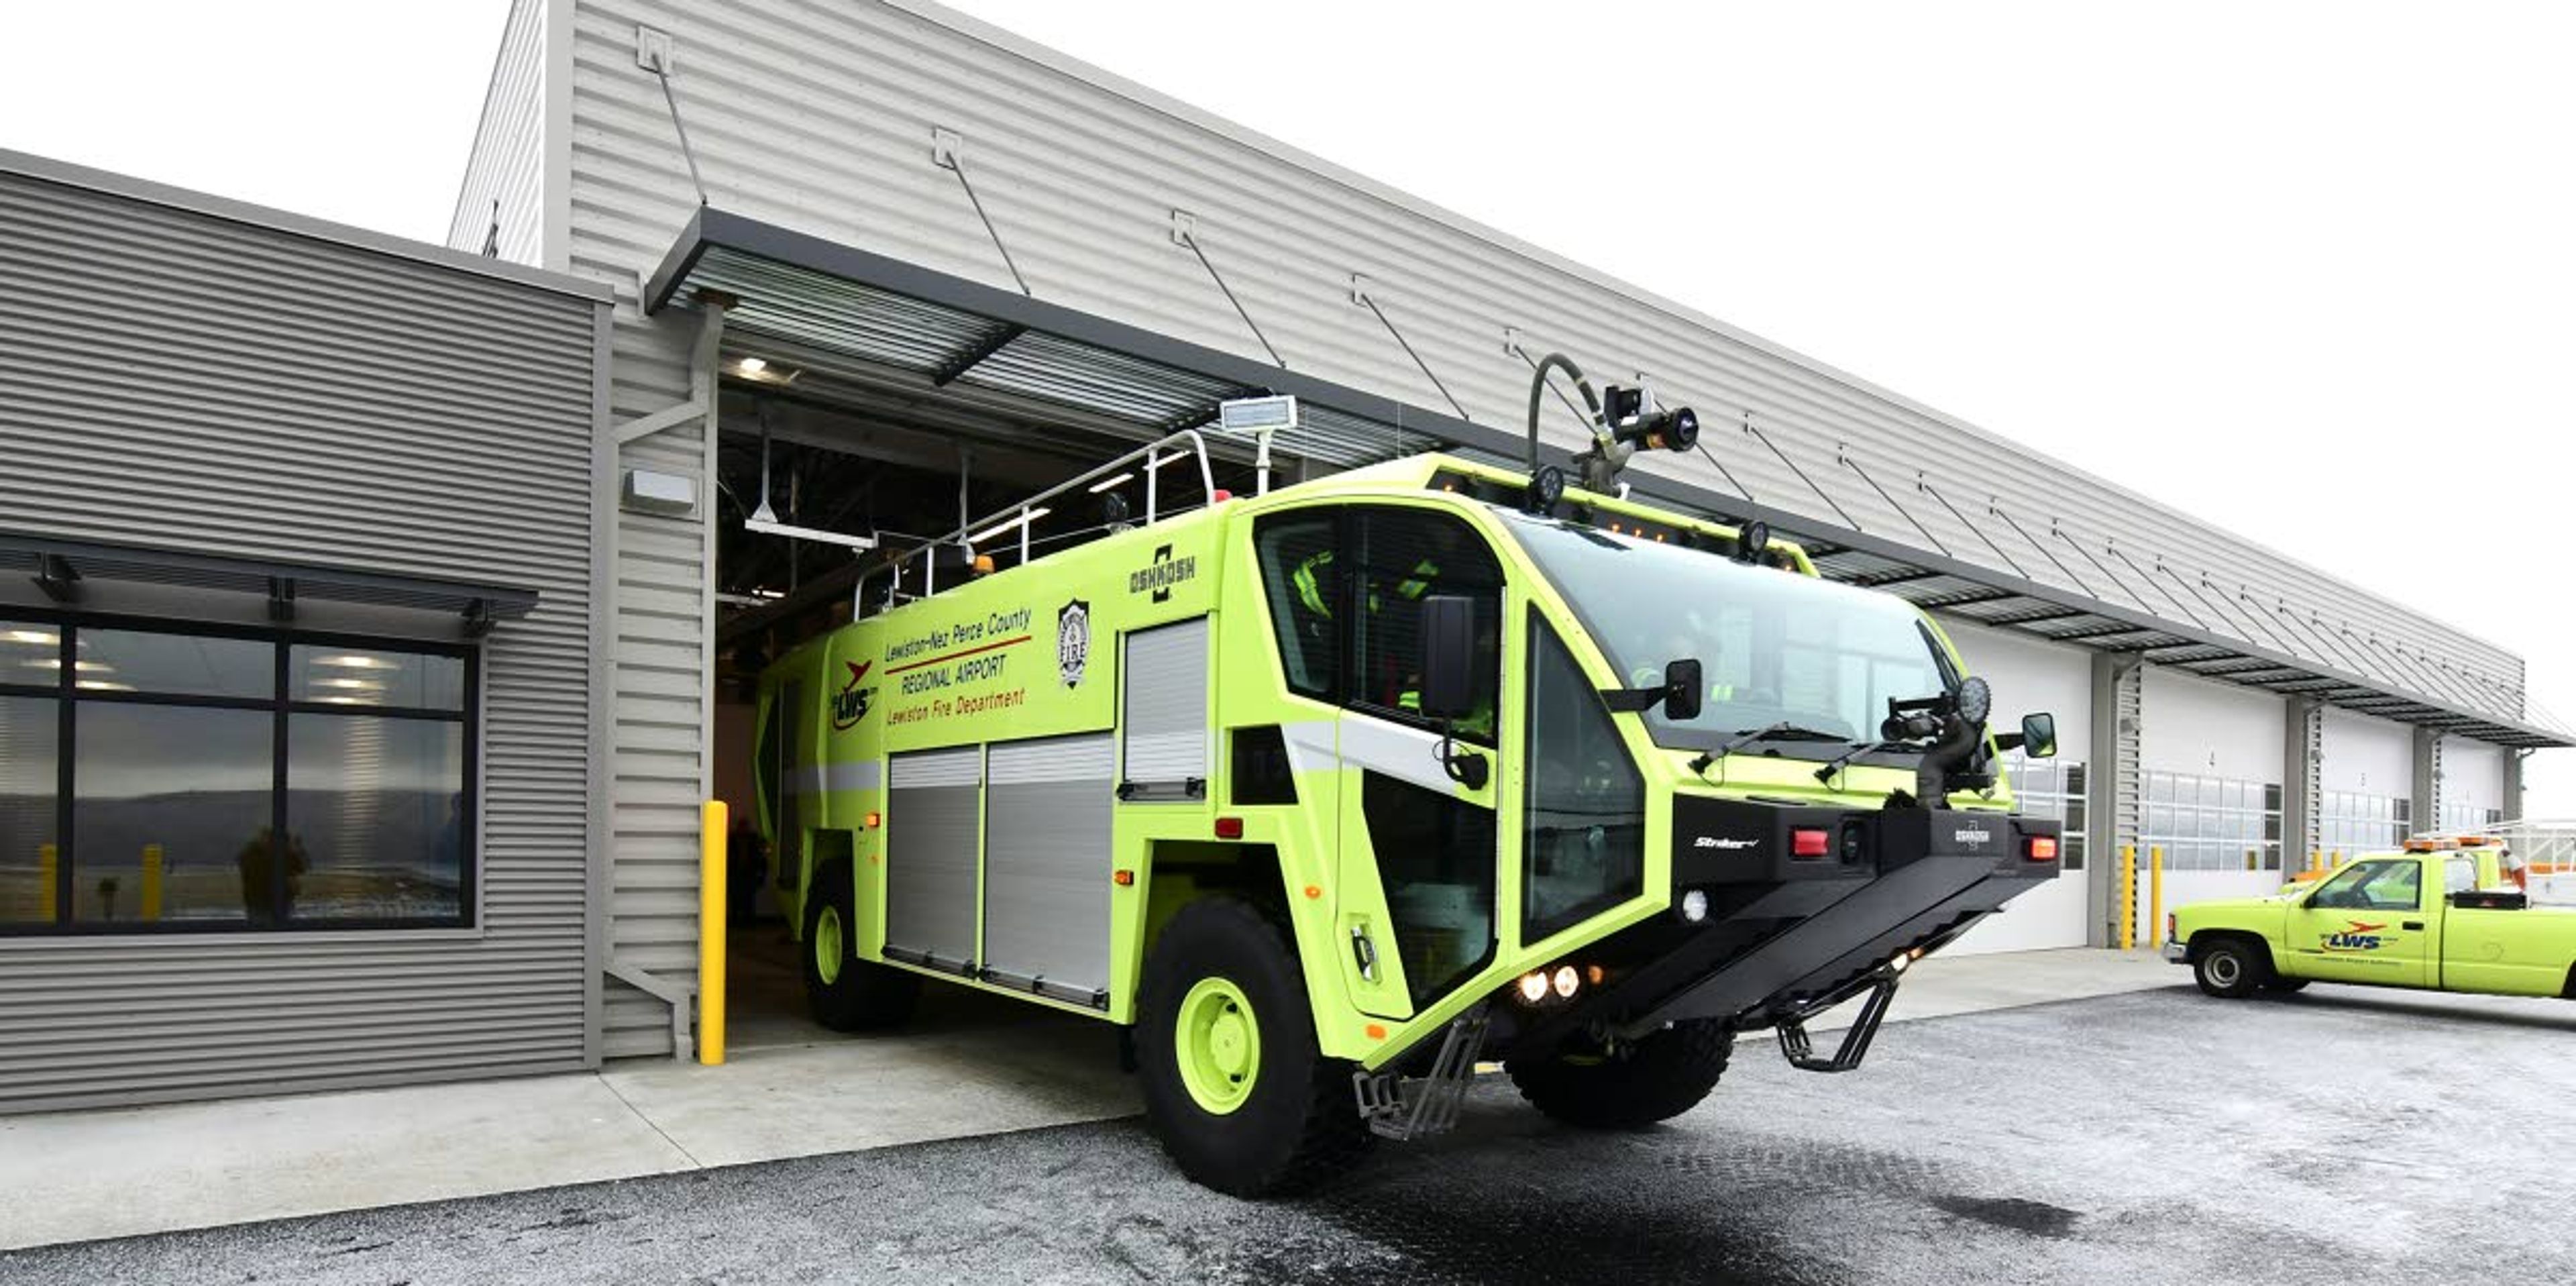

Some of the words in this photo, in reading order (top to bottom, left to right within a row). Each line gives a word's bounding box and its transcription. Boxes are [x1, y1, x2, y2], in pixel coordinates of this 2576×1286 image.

[1130, 555, 1195, 594] OSHKOSH
[885, 631, 949, 662] Lewiston-Nez
[953, 622, 983, 643] Perce
[987, 608, 1032, 636] County
[1060, 642, 1085, 662] FIRE
[902, 667, 951, 695] REGIONAL
[955, 653, 1006, 684] AIRPORT
[887, 706, 928, 727] Lewiston
[932, 699, 952, 717] Fire
[956, 688, 1025, 716] Department
[2329, 933, 2381, 949] LWS
